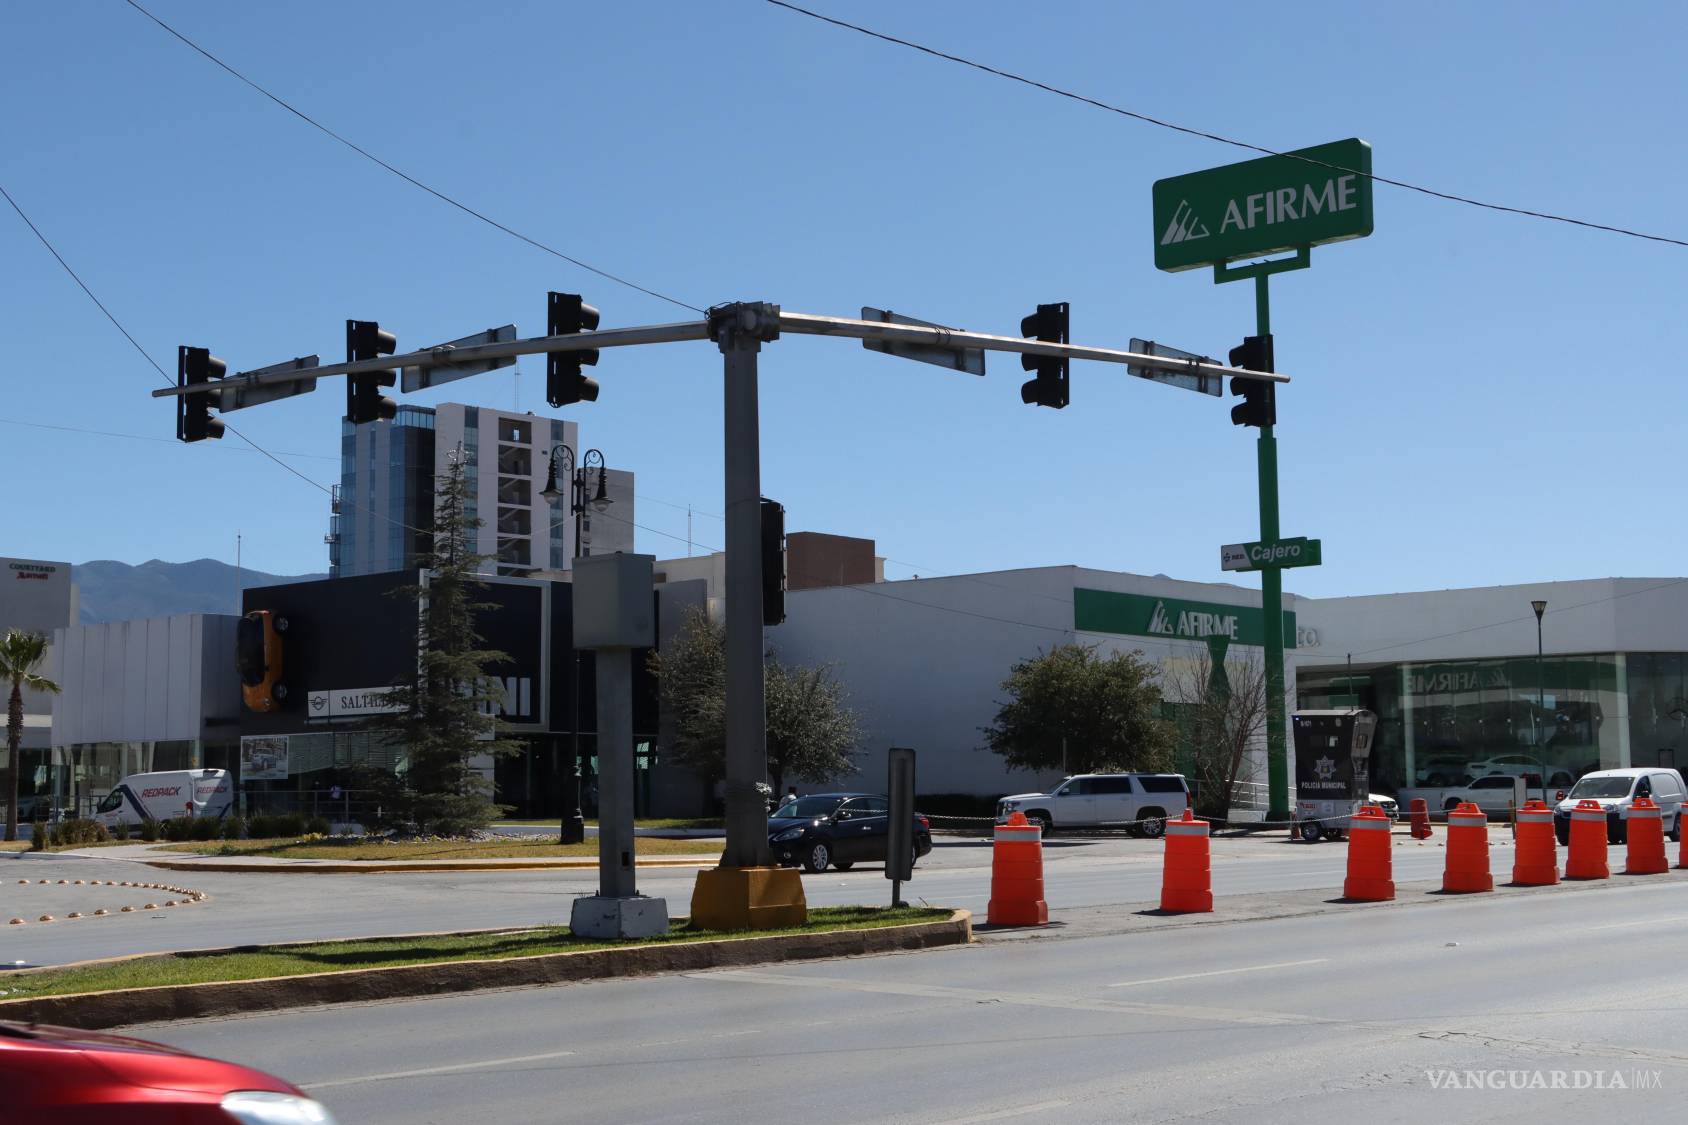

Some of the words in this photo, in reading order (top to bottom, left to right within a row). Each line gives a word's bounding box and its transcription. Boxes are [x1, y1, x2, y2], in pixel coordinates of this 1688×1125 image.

[1220, 175, 1357, 234] AFIRME
[1251, 544, 1300, 563] Cajero
[1176, 610, 1239, 641] AFIRME
[141, 786, 182, 798] REDPACK
[197, 785, 228, 794] REDPACK
